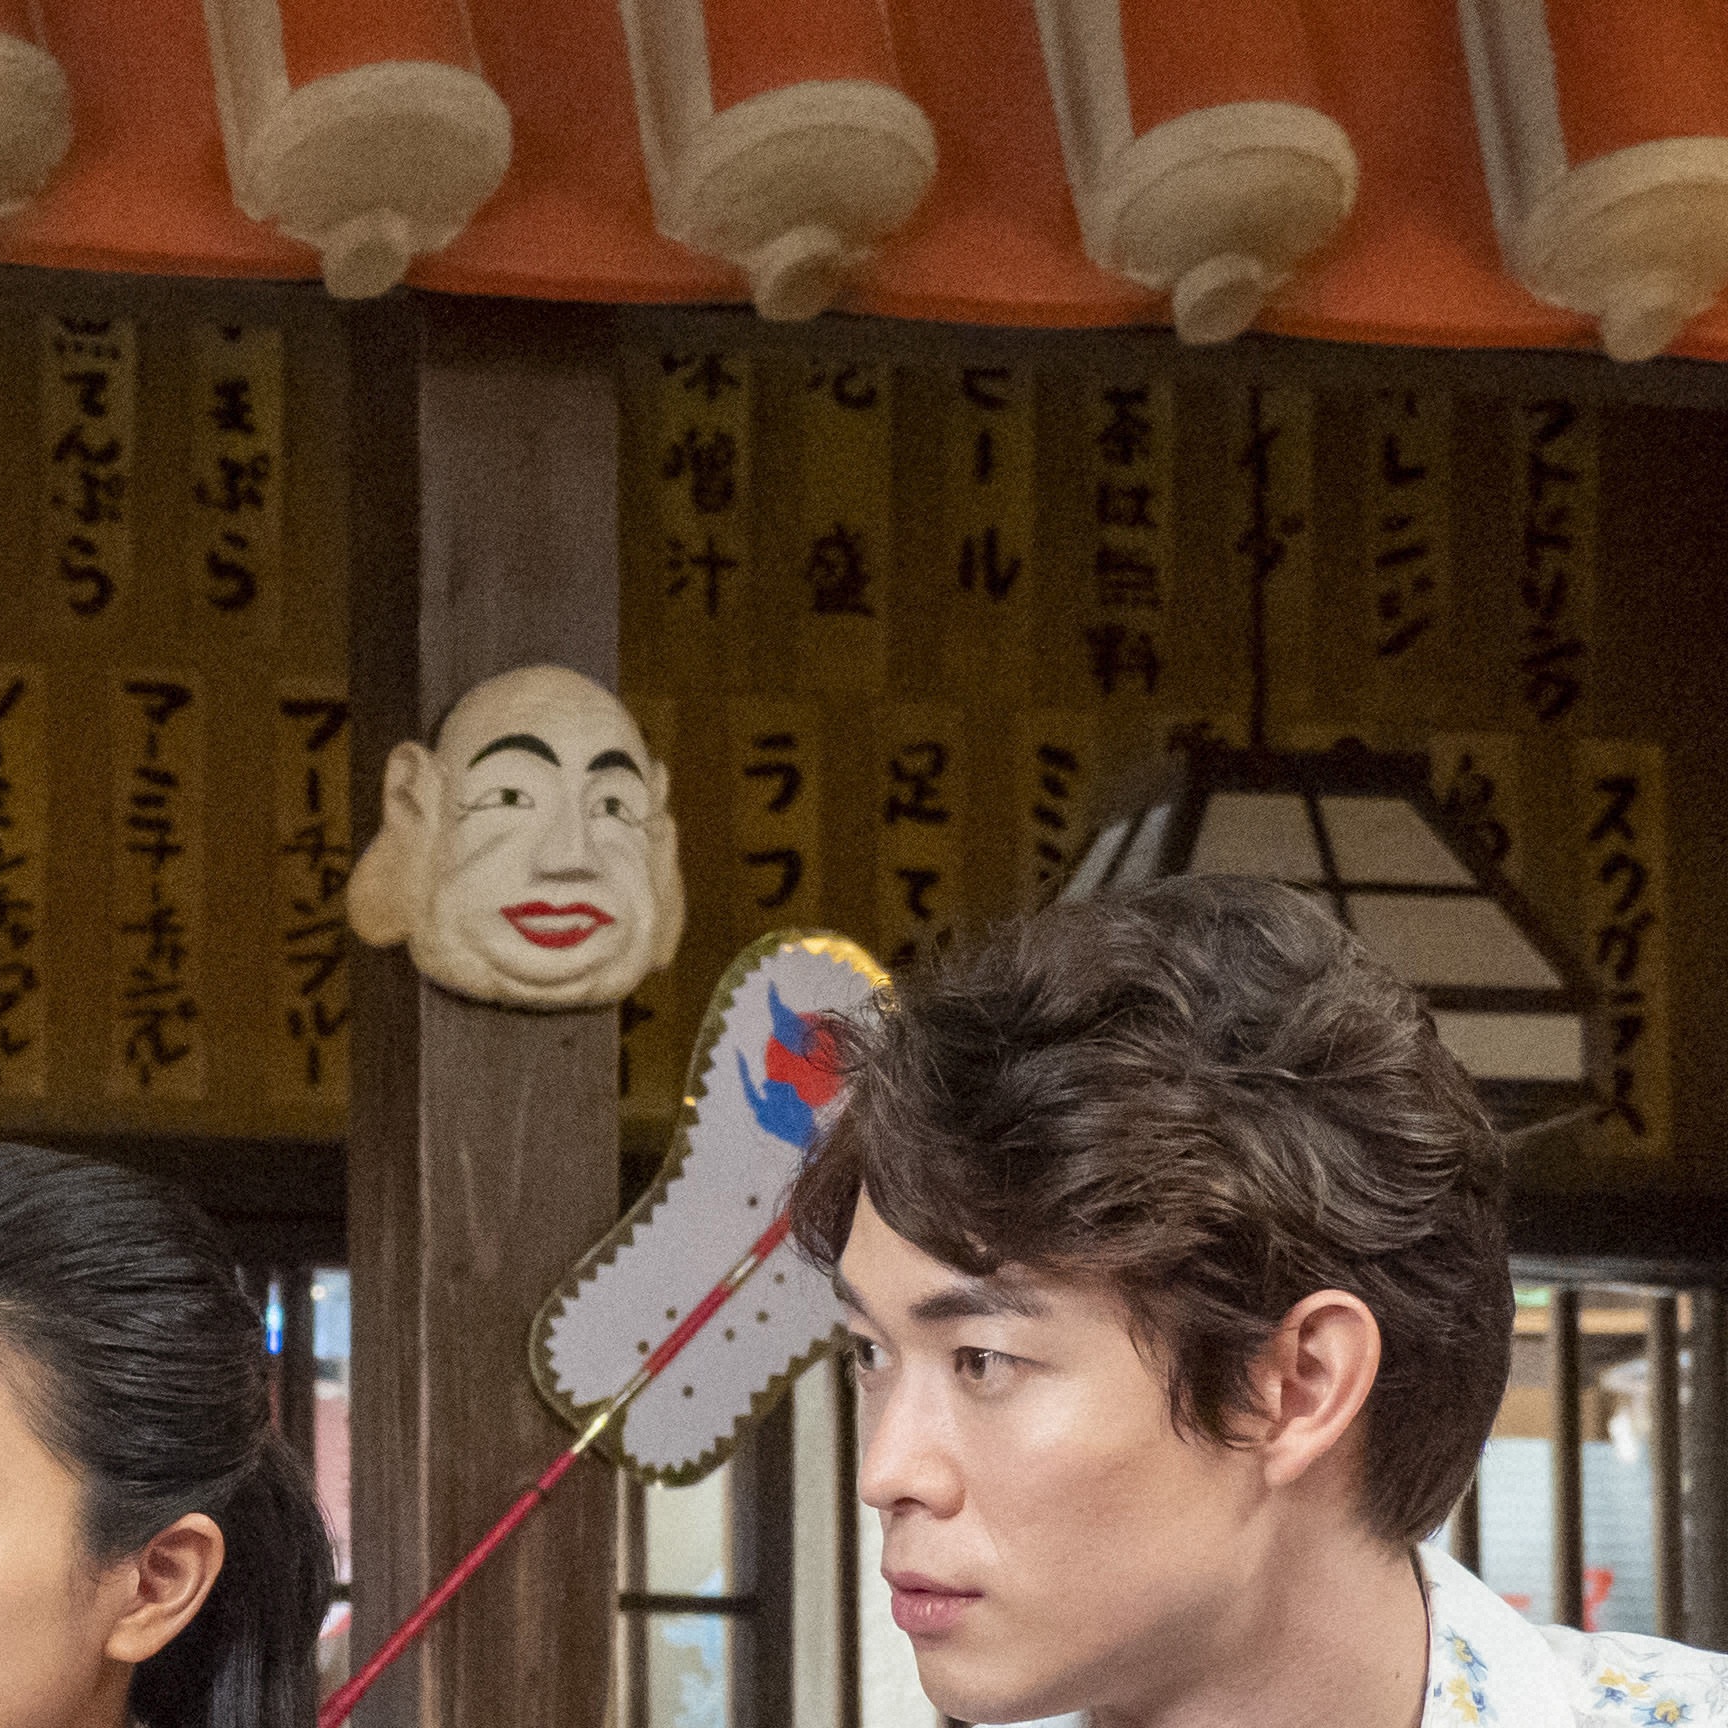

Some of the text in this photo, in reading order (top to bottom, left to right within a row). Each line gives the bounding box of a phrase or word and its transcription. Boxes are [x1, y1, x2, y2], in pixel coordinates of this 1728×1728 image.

[192, 324, 271, 612] 天ぷら
[1374, 392, 1436, 657] レンジ
